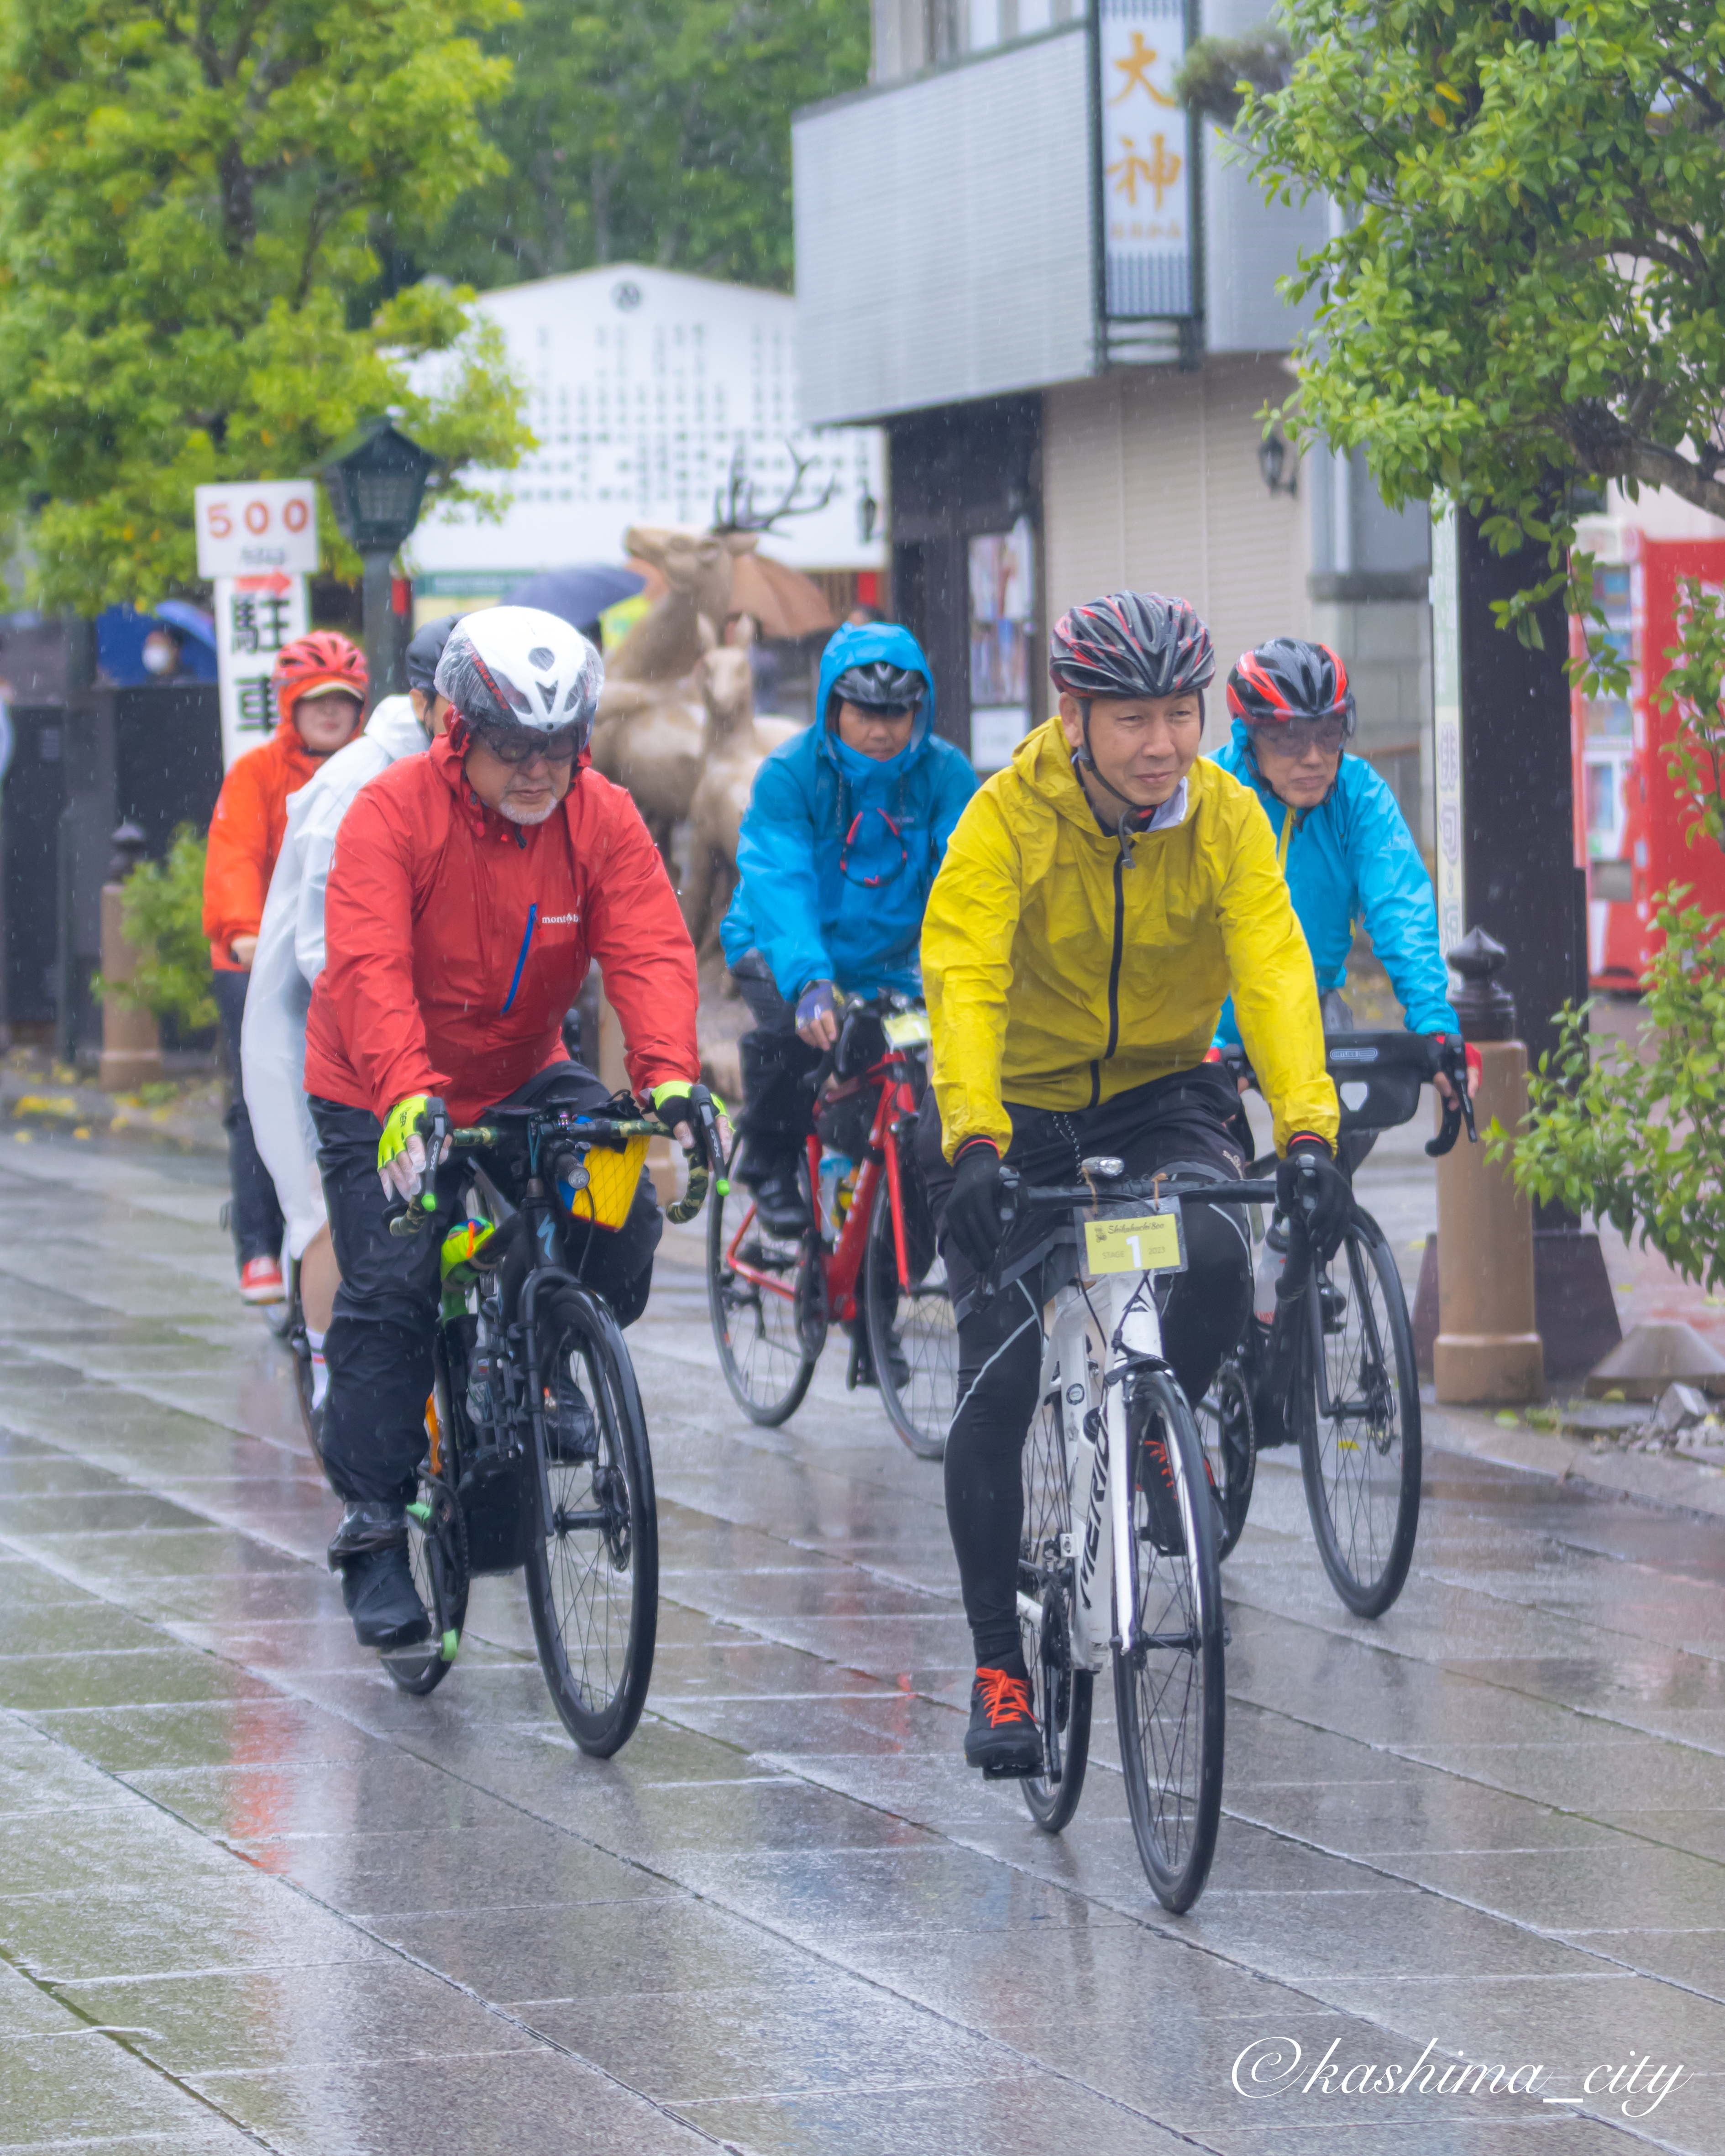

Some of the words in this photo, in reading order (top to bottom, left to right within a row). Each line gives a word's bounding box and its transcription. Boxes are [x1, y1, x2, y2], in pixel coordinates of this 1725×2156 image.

[1107, 30, 1181, 212] 大神
[207, 498, 309, 539] 500
[1102, 1250, 1124, 1259] STAGE
[1125, 1235, 1142, 1268] 1
[1148, 1246, 1166, 1255] 2023
